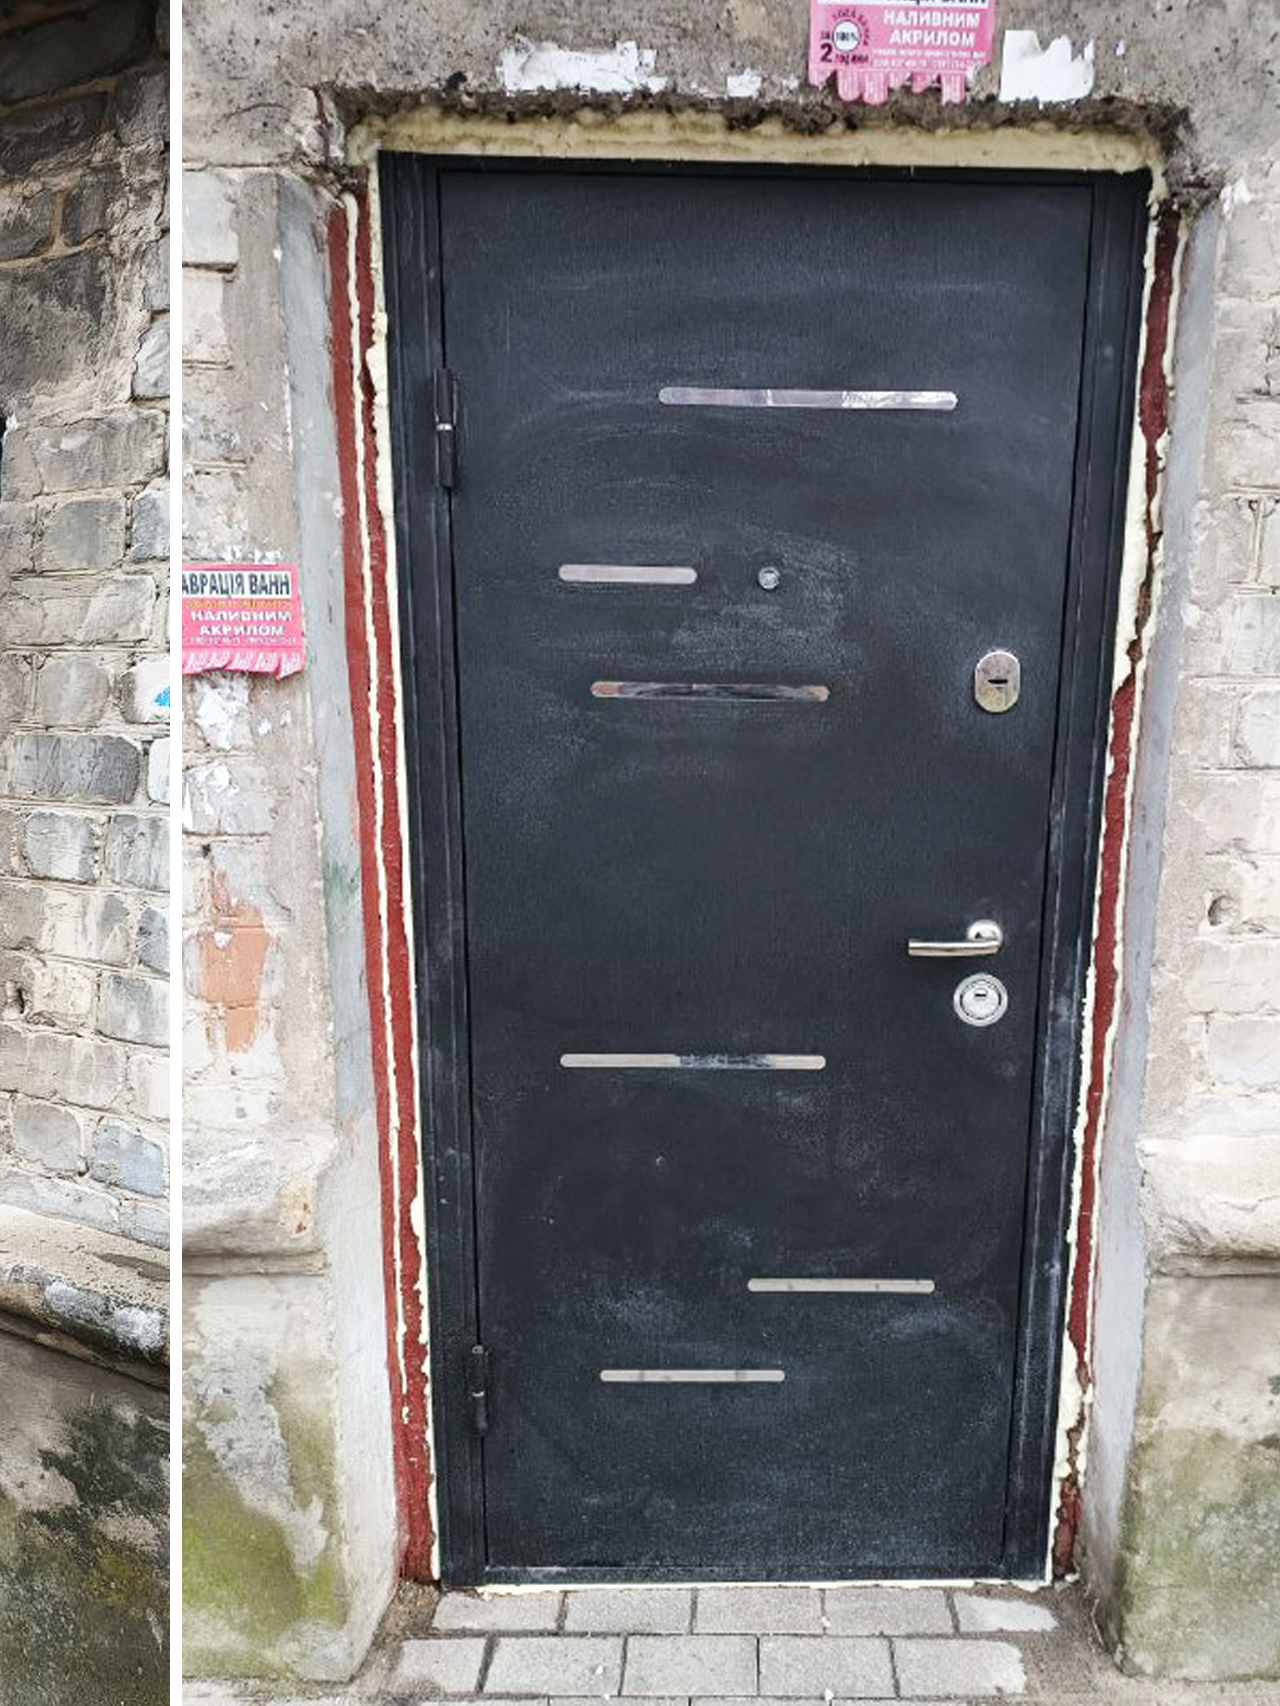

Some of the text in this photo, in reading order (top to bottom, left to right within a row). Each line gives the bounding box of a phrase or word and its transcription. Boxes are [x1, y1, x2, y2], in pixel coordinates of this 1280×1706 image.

[883, 9, 980, 28] НАЛИВНИМ
[889, 28, 975, 47] АКРИЛОМ
[820, 42, 833, 63] 2
[249, 573, 290, 595] ВАНН
[190, 610, 292, 622] НАЛИВНИМ
[200, 624, 285, 636] АКРИЛОМ
